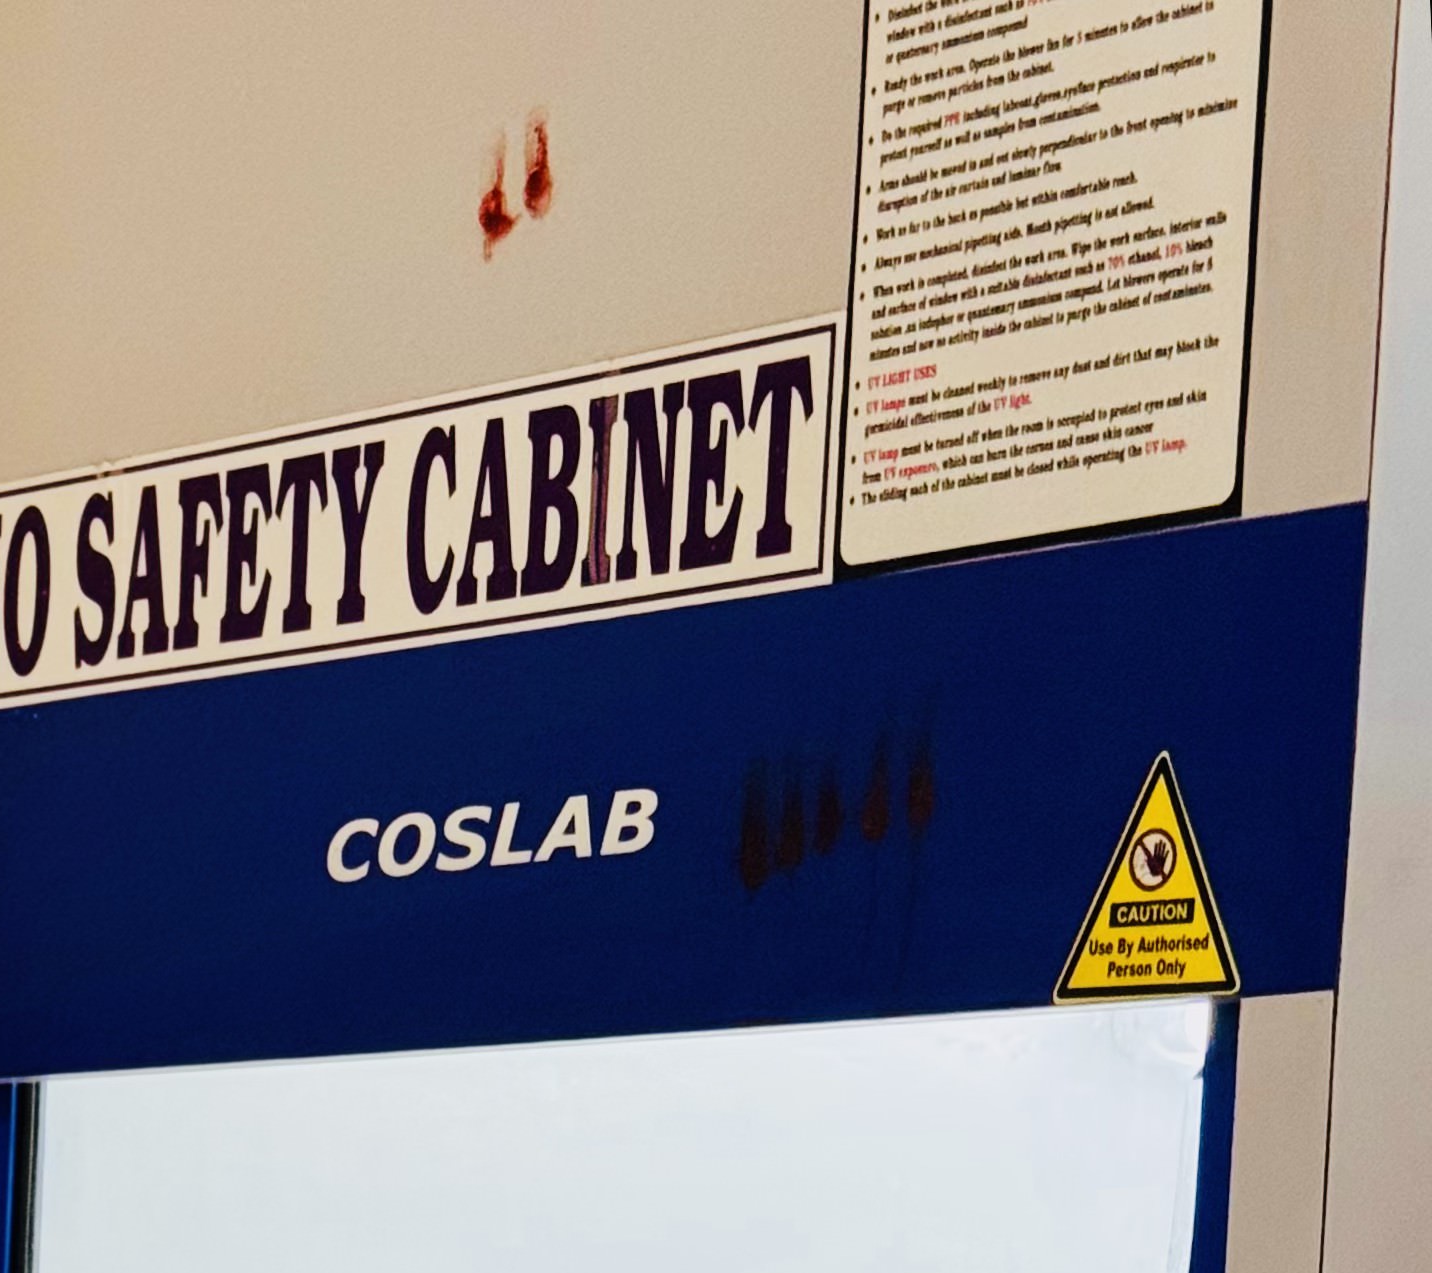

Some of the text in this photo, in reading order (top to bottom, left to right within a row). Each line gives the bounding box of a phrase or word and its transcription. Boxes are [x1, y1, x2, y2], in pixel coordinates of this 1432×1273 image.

[72, 440, 386, 669] SAFETY
[405, 356, 814, 615] CABINET
[326, 788, 660, 883] COSLAB
[1117, 902, 1188, 923] CAUTION
[1089, 932, 1209, 958] Use By Authorised
[1107, 957, 1186, 979] Person Only
